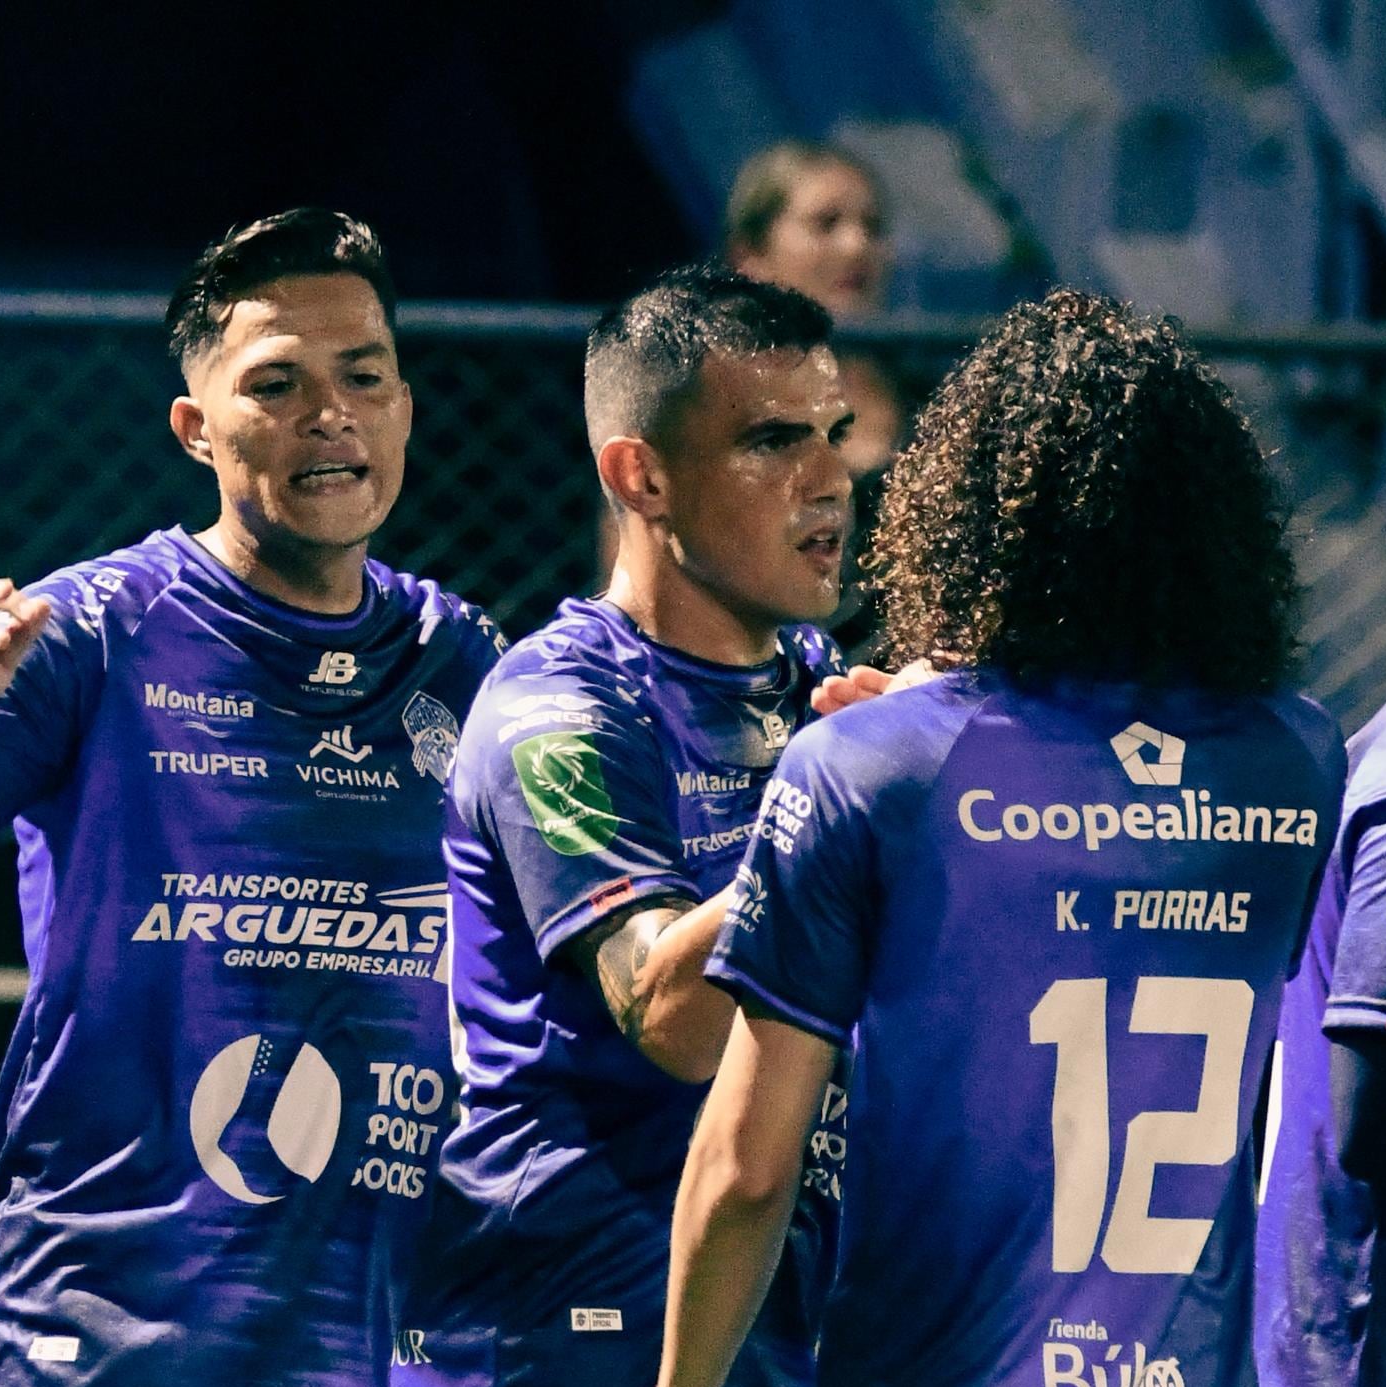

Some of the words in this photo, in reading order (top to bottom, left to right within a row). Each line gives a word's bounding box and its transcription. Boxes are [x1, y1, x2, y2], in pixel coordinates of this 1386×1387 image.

[308, 651, 356, 684] JB
[144, 683, 254, 719] Montaña
[148, 750, 270, 779] TRUPER
[295, 763, 401, 789] VICHIMA
[957, 789, 1318, 850] Coopealianza
[161, 873, 369, 905] TRANSPORTES
[130, 902, 448, 954] ARGUEDAS
[1056, 890, 1090, 932] K.
[1113, 890, 1252, 933] PORRAS
[223, 948, 301, 969] GRUPO
[1029, 976, 1256, 1275] 12
